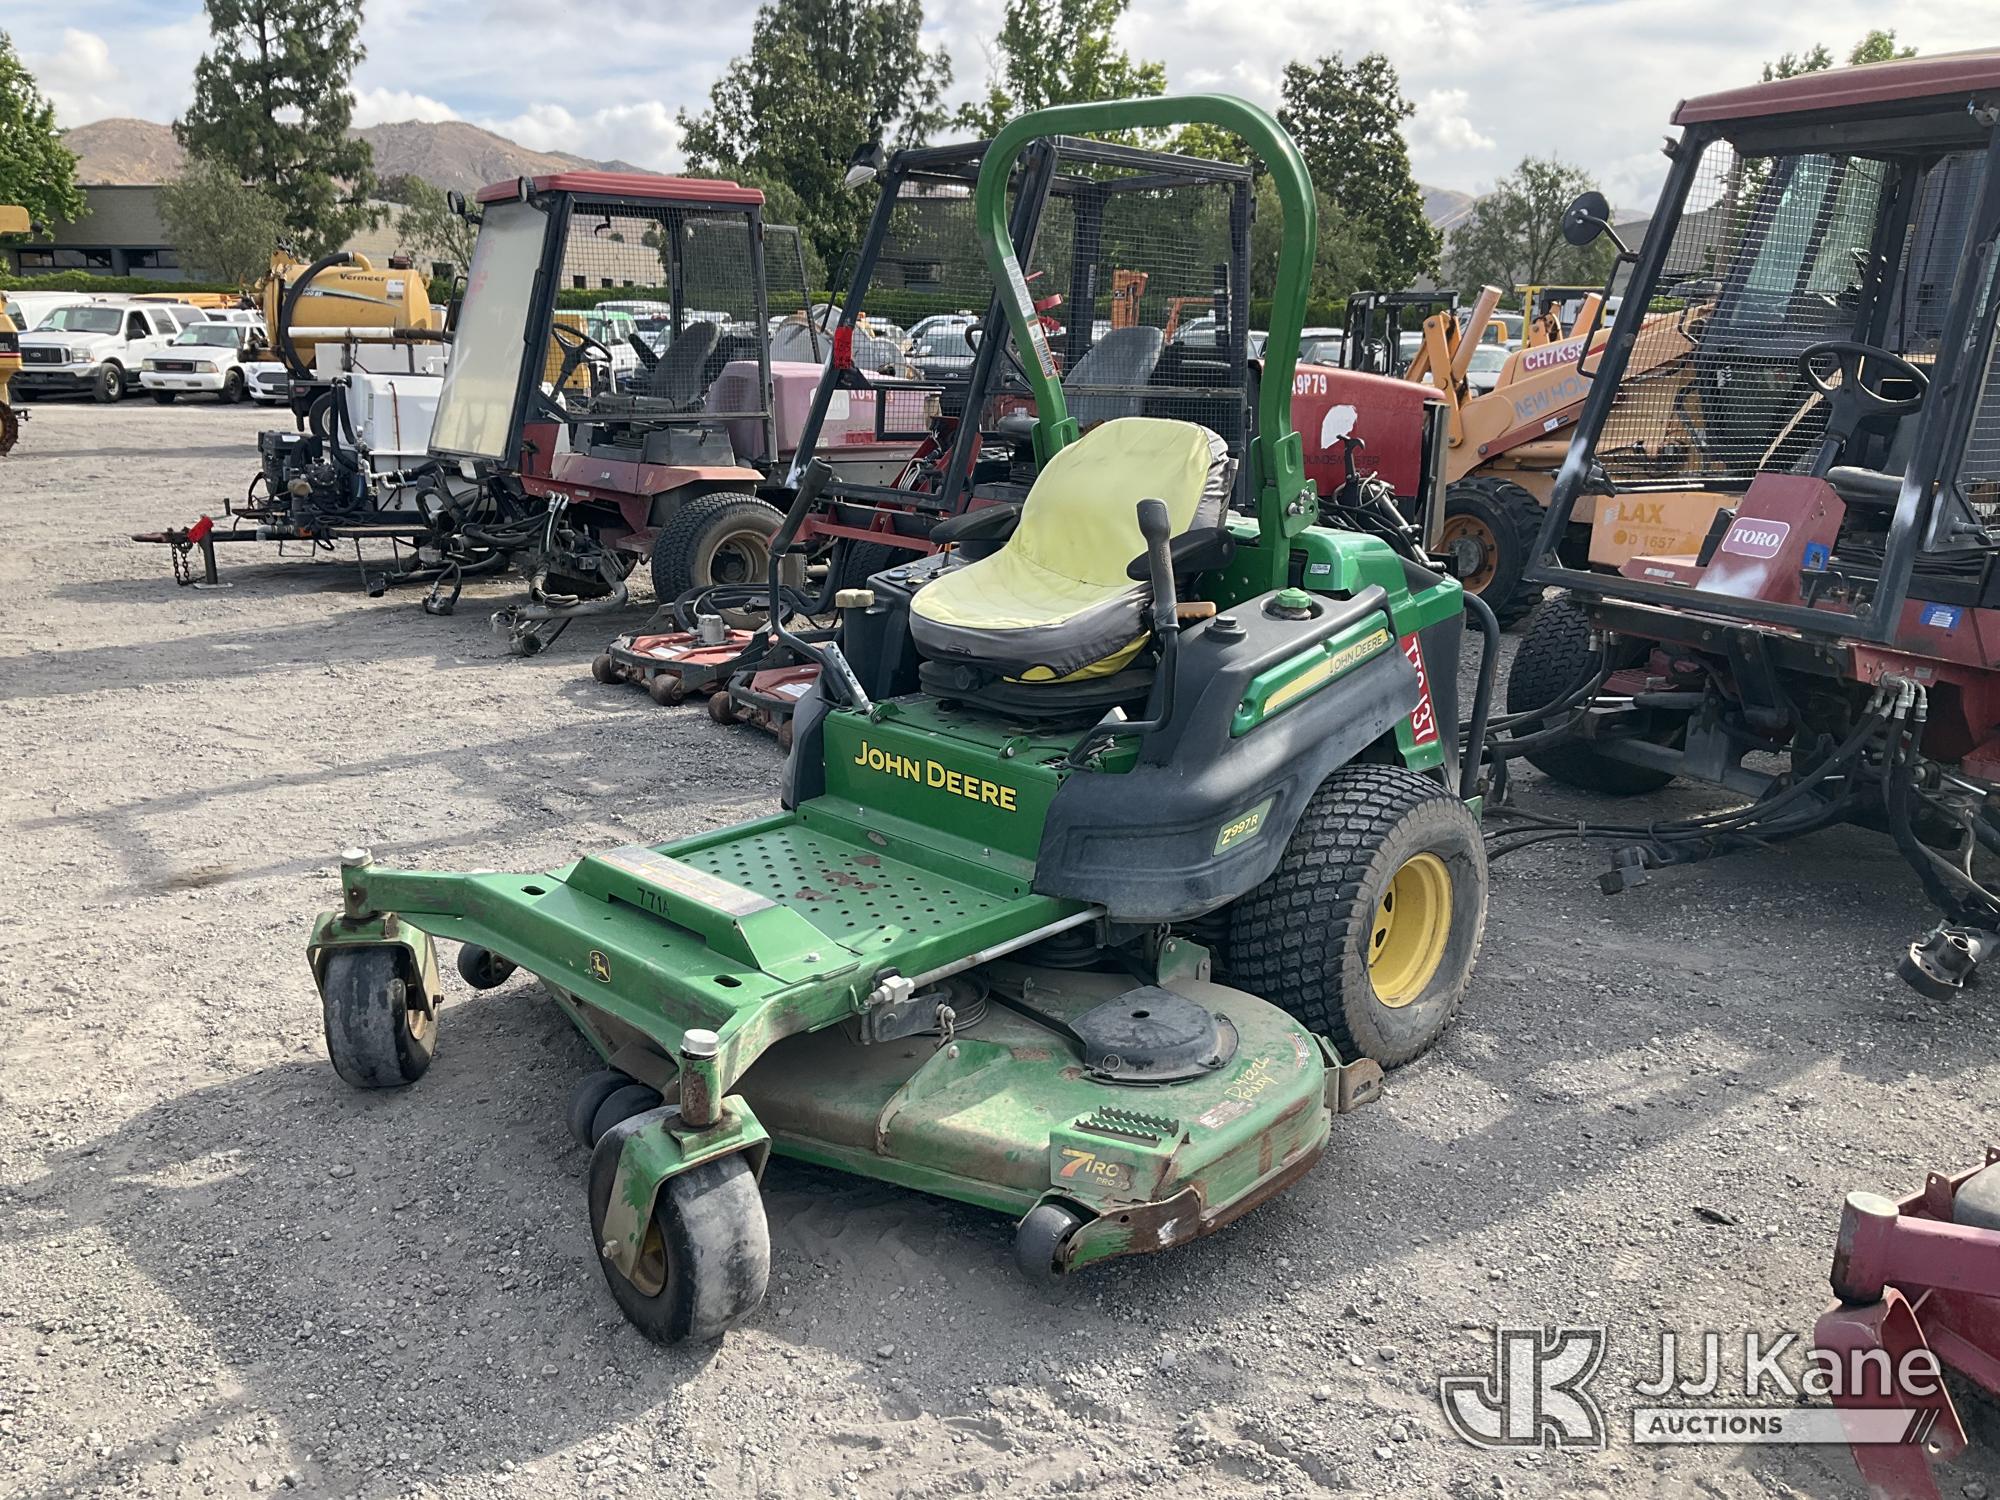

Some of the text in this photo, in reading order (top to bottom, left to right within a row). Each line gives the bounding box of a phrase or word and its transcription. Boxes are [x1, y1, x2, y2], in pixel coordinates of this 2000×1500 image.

[340, 273, 385, 282] Vermeer
[1617, 501, 1665, 525] LAX
[1733, 528, 1779, 547] TORO
[1330, 634, 1384, 674] JOHN DEERE
[854, 740, 1017, 812] JOHN DEERE
[1221, 813, 1259, 846] Z997R
[1096, 1176, 1116, 1187] PRO
